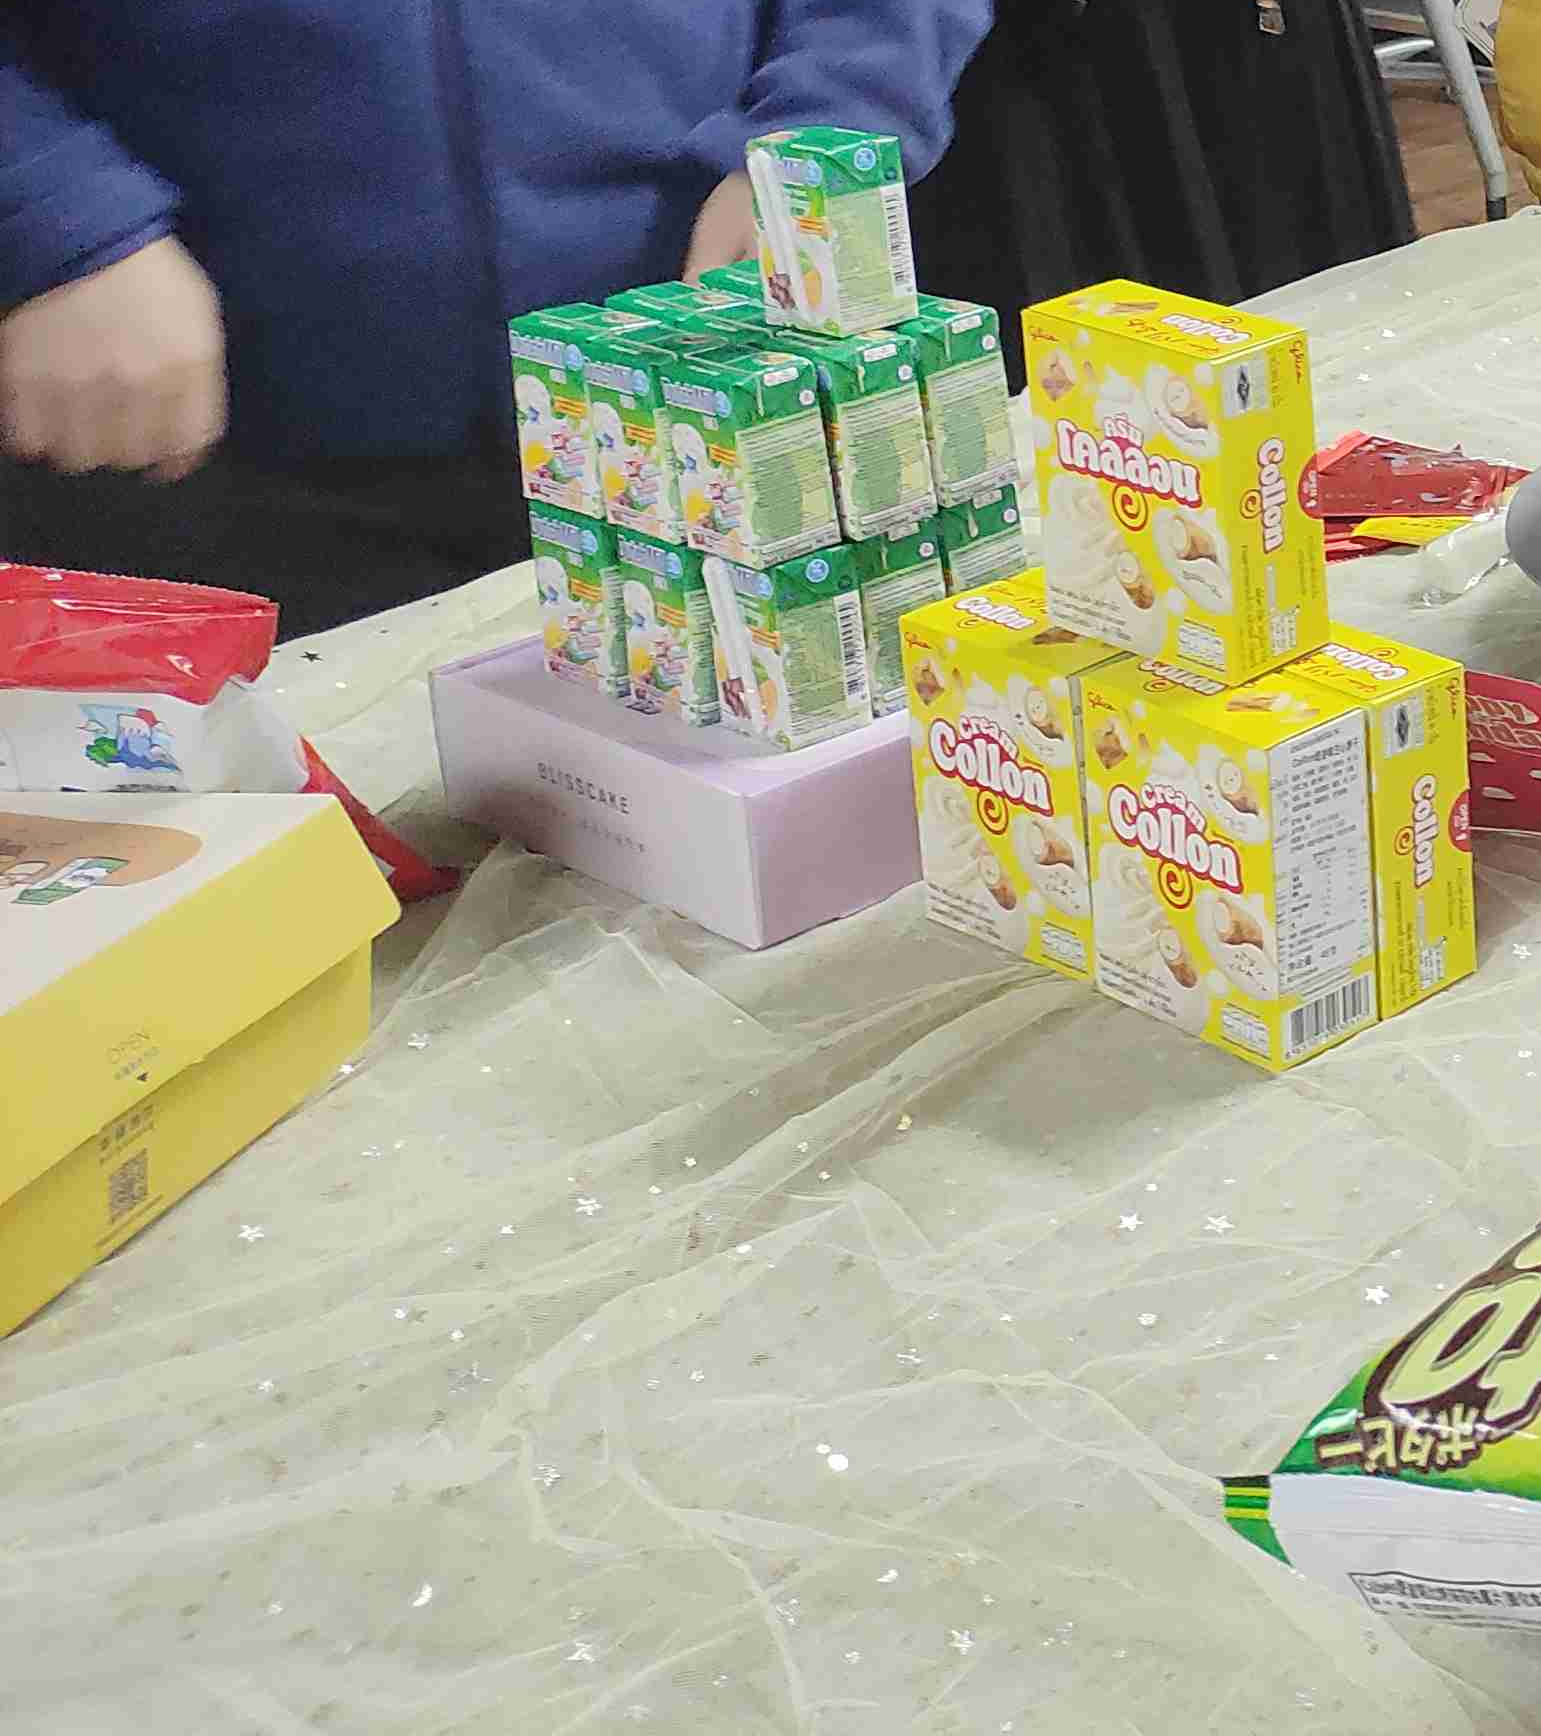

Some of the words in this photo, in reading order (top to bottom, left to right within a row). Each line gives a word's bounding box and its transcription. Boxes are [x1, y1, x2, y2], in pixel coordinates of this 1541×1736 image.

[1056, 417, 1203, 509] โคลลอน
[1256, 436, 1288, 554] Collon
[929, 717, 1055, 818] Collon
[1107, 782, 1244, 895] Collon
[1410, 772, 1439, 890] Collon
